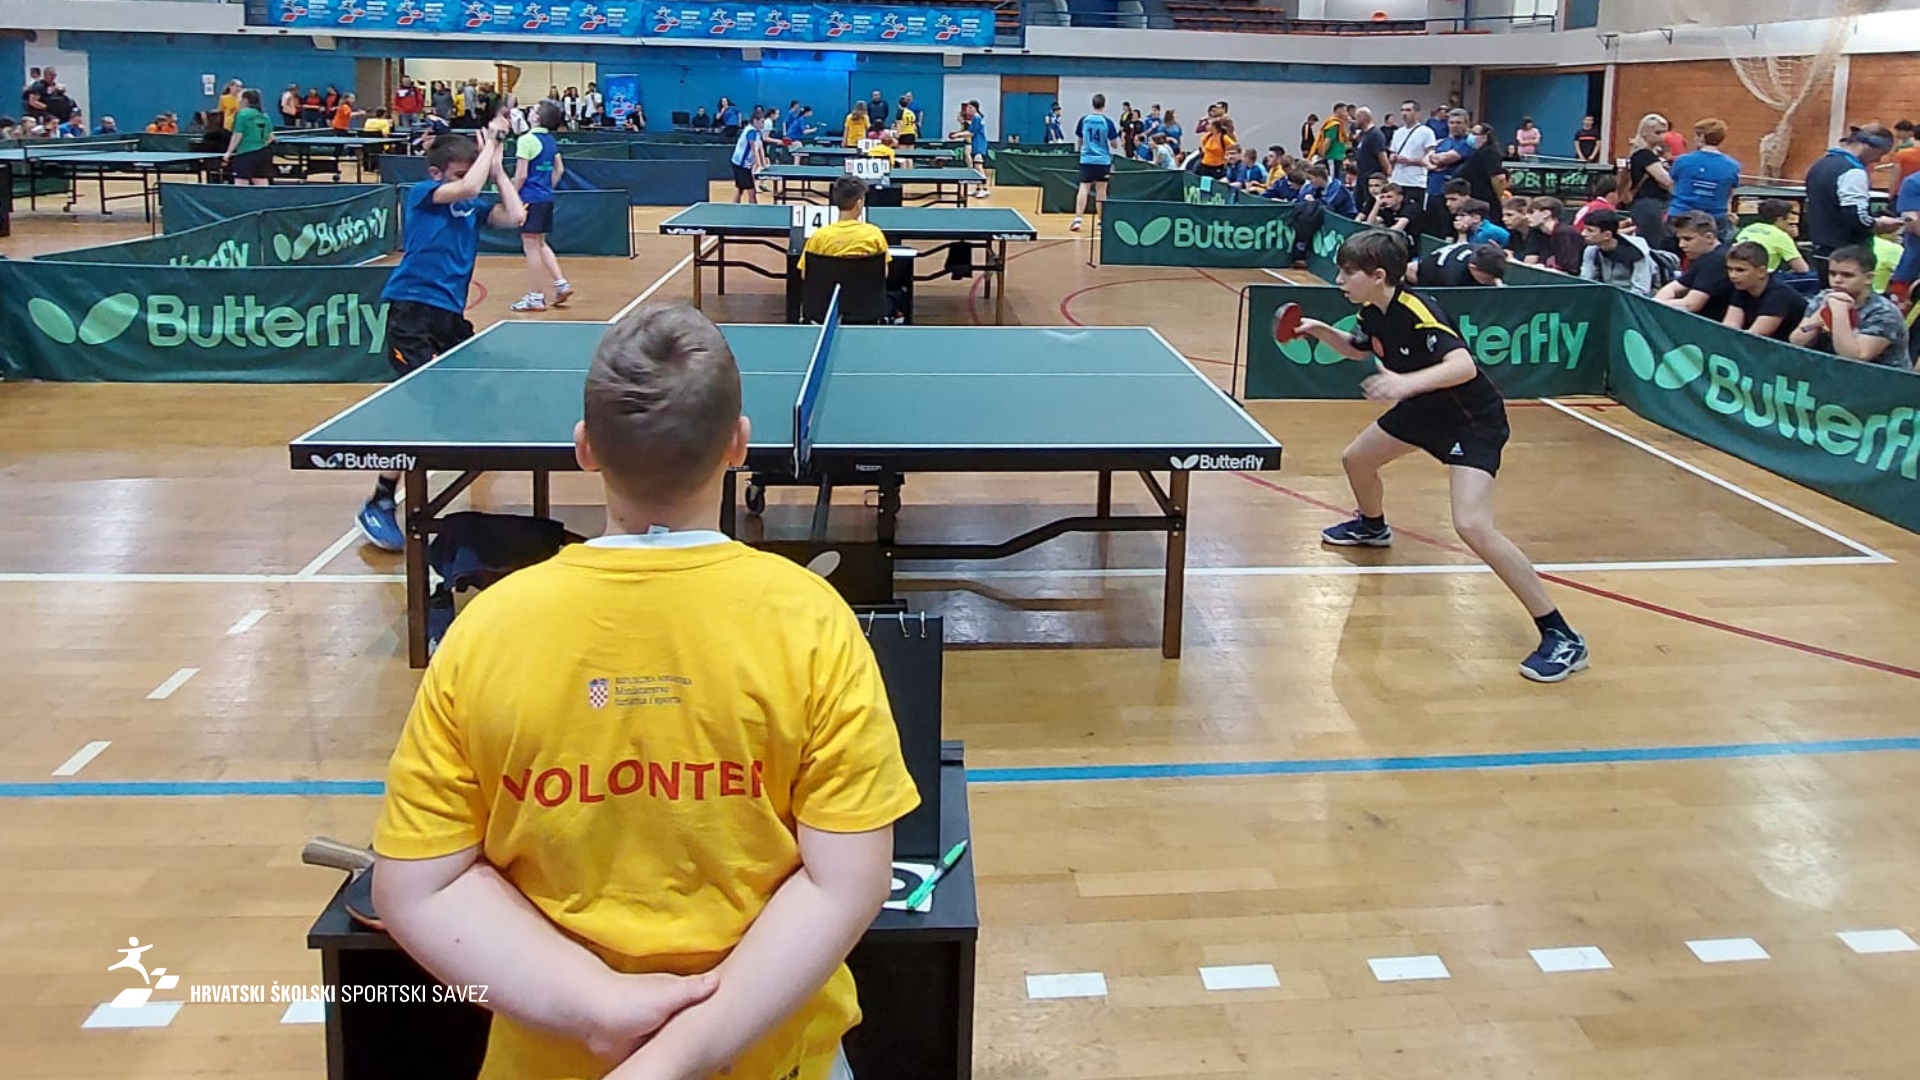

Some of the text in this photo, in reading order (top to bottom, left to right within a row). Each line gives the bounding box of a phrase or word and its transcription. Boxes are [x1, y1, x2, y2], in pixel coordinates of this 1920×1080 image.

[1088, 127, 1102, 143] 14
[857, 162, 863, 174] 0
[873, 162, 879, 174] 0
[812, 212, 823, 229] 4
[1174, 218, 1296, 253] Butterfly
[146, 293, 390, 354] Butterfly
[1459, 313, 1589, 369] terfly
[344, 453, 416, 471] Butterfly
[1200, 454, 1264, 471] Butterfly
